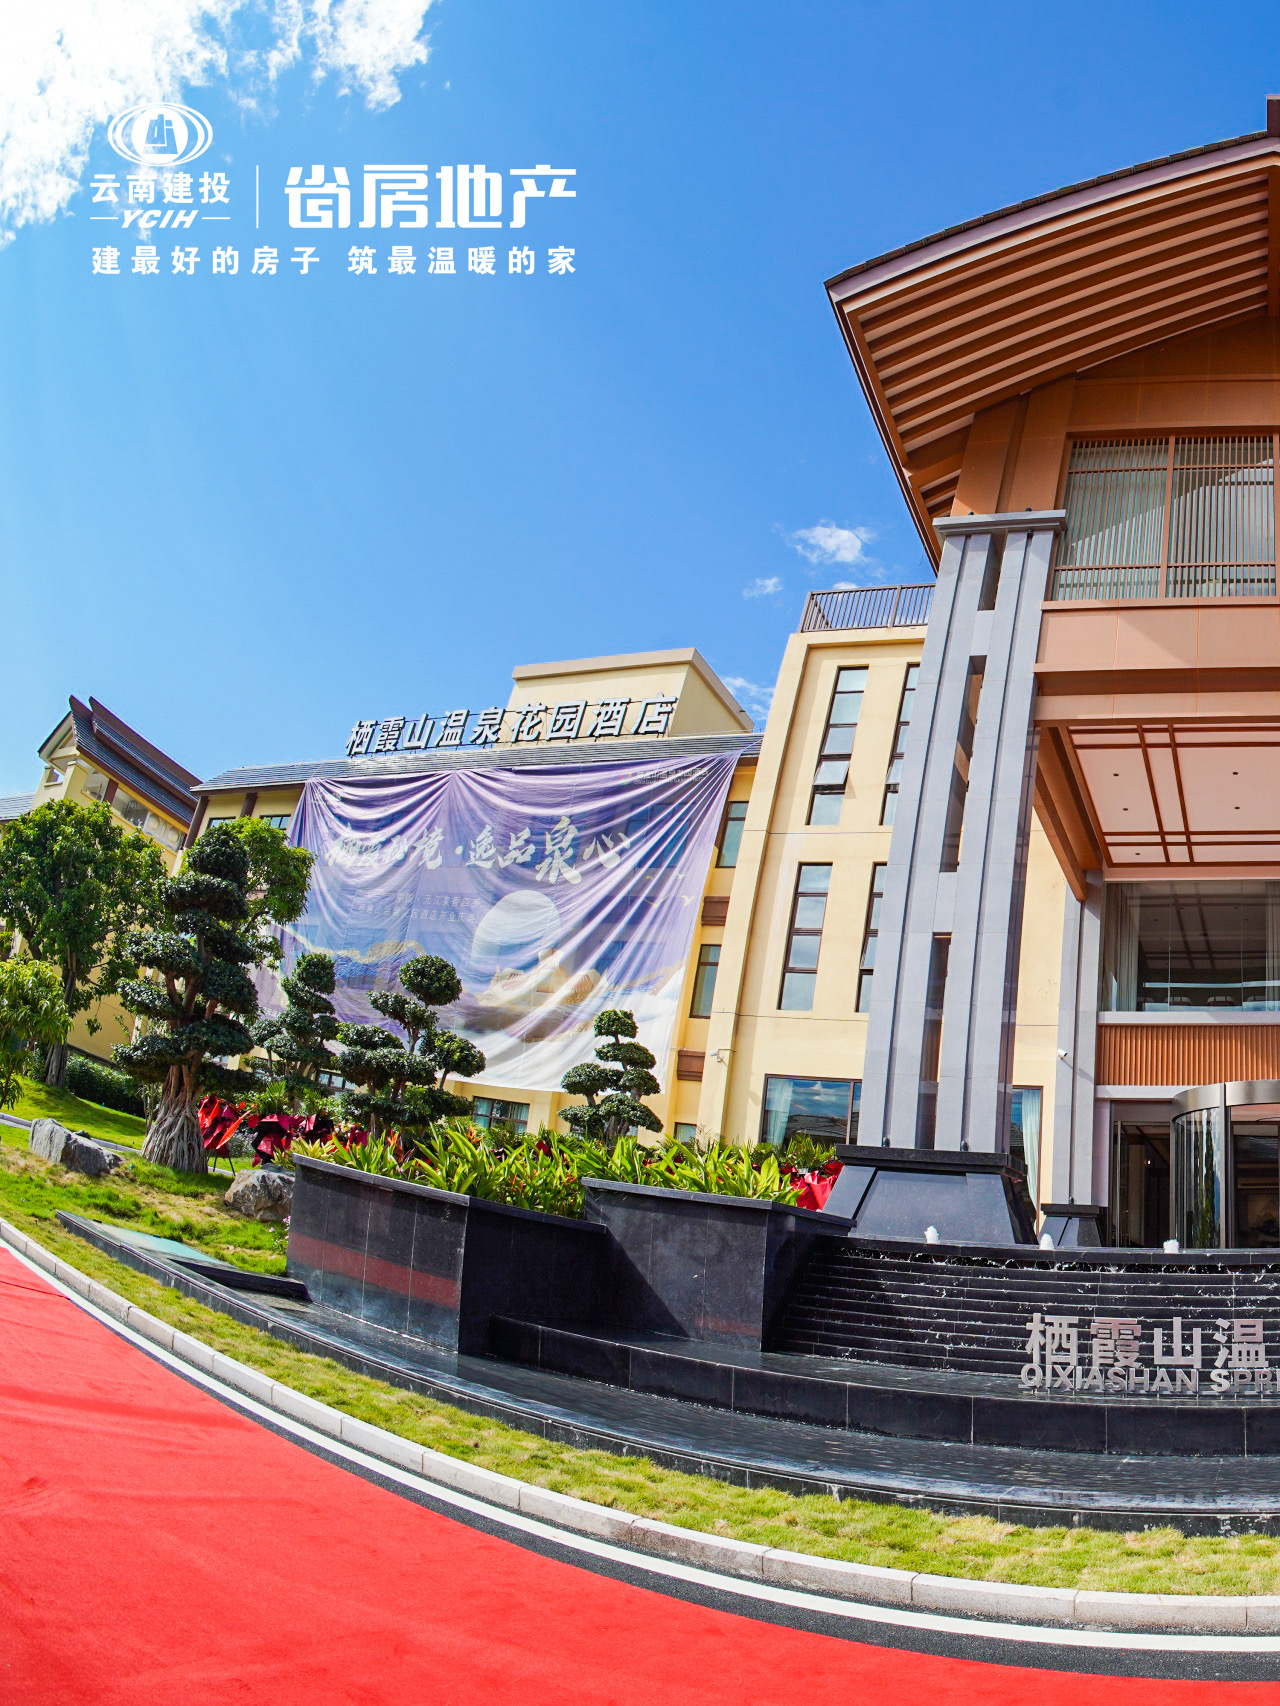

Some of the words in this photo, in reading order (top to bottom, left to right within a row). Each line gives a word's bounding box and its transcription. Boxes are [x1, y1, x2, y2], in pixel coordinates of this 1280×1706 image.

[346, 693, 678, 755] 栖霞山温泉花园酒店
[1020, 1363, 1199, 1393] QIXIASHAN
